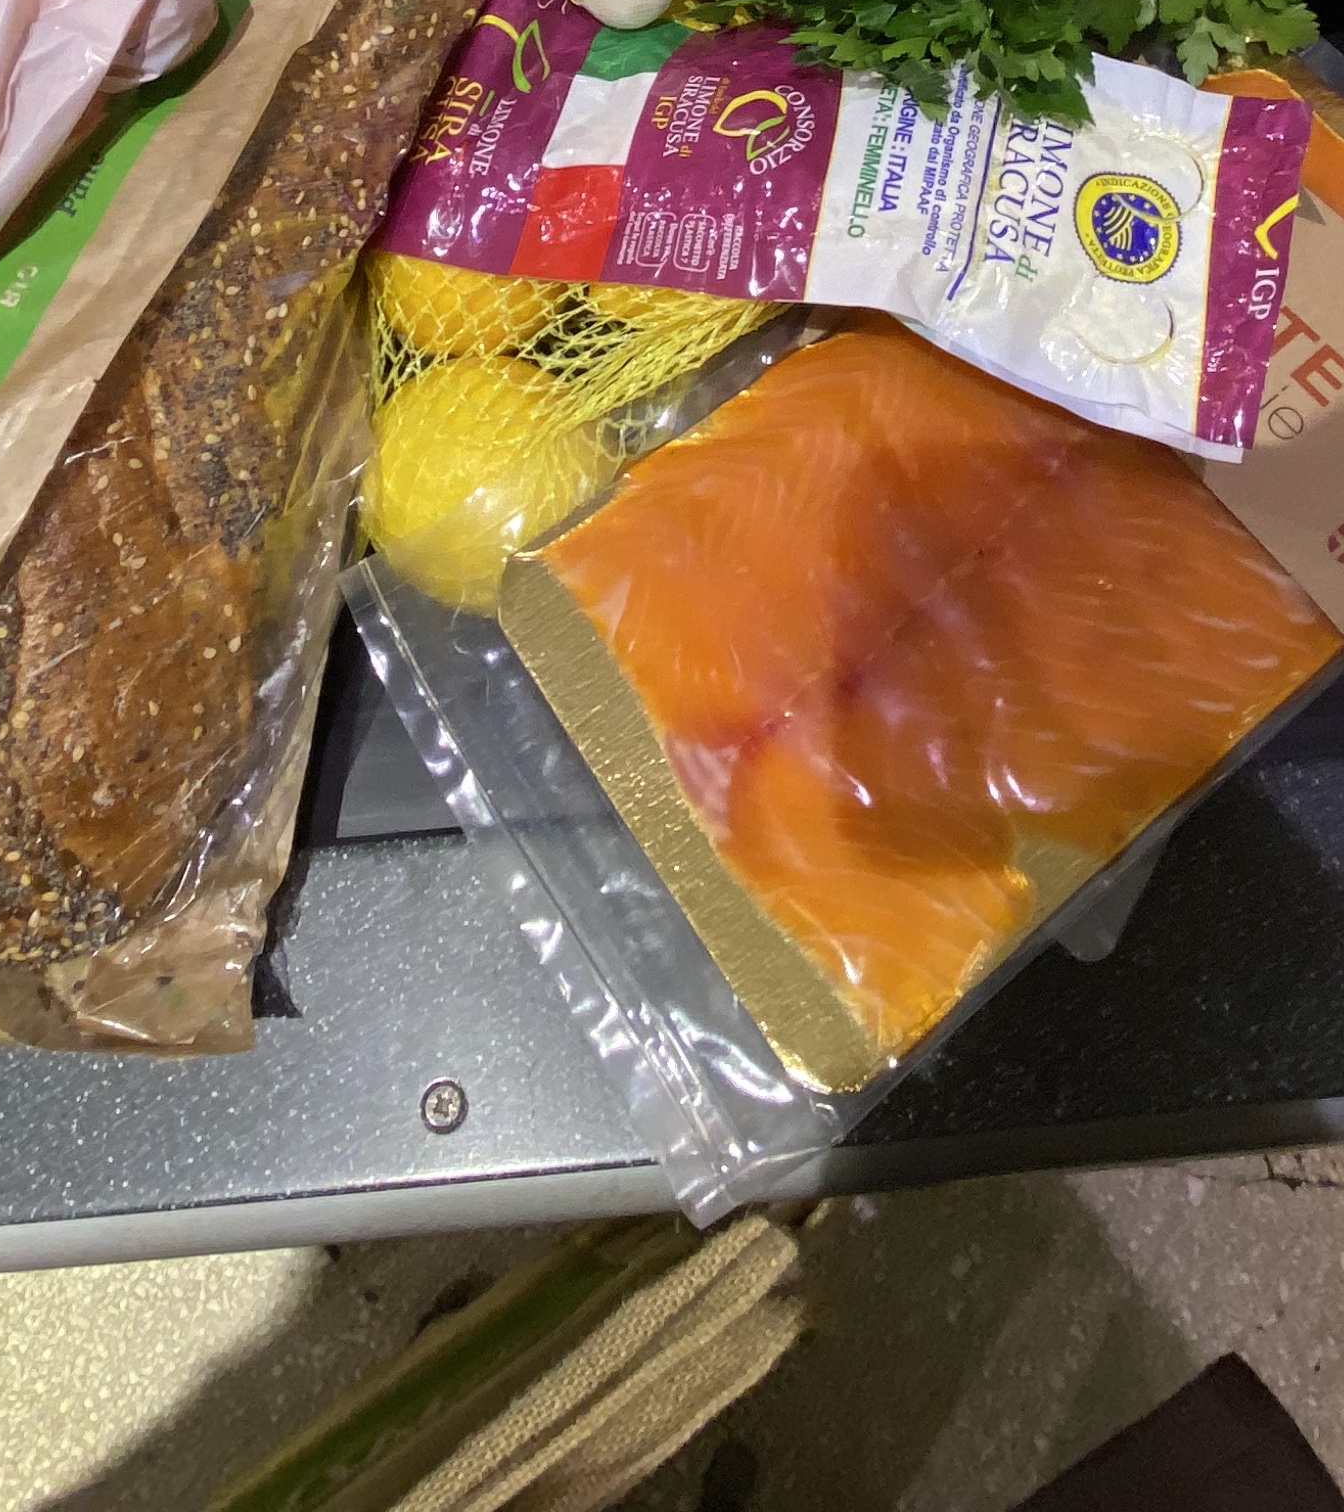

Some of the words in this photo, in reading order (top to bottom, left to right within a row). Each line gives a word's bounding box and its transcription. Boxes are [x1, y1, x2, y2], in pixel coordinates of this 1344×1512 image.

[424, 76, 484, 166] SIRA
[467, 123, 483, 137] di
[468, 97, 518, 178] LIMONE
[651, 95, 678, 130] IGP
[662, 74, 704, 158] SIRACUSA
[681, 75, 722, 144] LIMONE
[748, 84, 816, 176] CONSORZIO
[678, 144, 693, 159] di
[847, 123, 890, 239] FEMMINELLO
[937, 126, 961, 186] Organismo
[956, 124, 982, 203] GEOGRAFICA
[877, 154, 908, 213] ITALIA
[916, 165, 938, 216] MIPAAF
[983, 117, 1042, 265] RACUSA
[1022, 120, 1075, 258] IMONE
[1099, 177, 1172, 211] INDICAZIONE
[717, 214, 734, 279] DIFFERENZIATA
[729, 225, 743, 270] RACCOLTA
[921, 201, 943, 257] controllo
[1014, 253, 1039, 283] di
[1246, 265, 1280, 322] IGP
